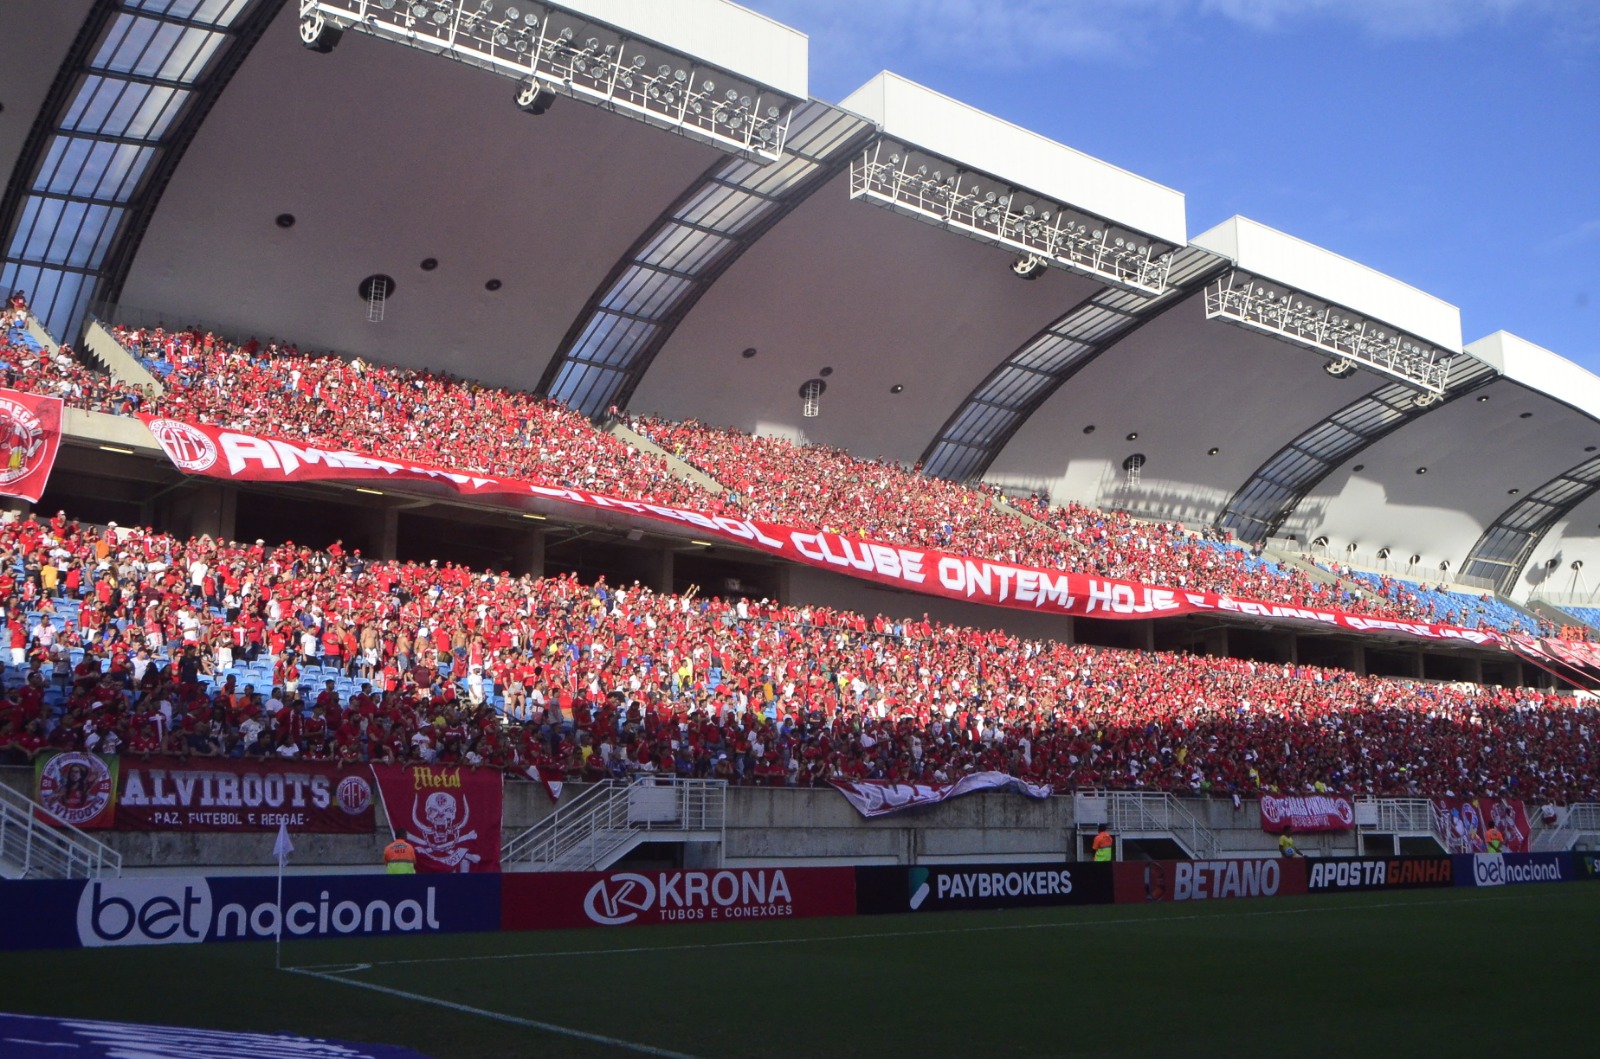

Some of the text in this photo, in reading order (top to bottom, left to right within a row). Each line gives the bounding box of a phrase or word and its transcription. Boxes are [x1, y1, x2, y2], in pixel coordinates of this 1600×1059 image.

[790, 531, 926, 583] CLUBE
[1086, 579, 1180, 614] HOJE
[121, 769, 330, 809] ALVIROOTS
[413, 766, 461, 790] Metal
[188, 813, 242, 825] FUTEBOL
[248, 814, 256, 825] E
[261, 814, 304, 825] REGGAE
[937, 870, 1073, 899] PAYBROKERS
[1174, 859, 1280, 901] BETANO
[1475, 854, 1562, 883] bet nacional
[659, 870, 792, 907] KRONA
[91, 883, 440, 941] bet nacional
[660, 903, 793, 920] TUBOS E CONEXÕES
